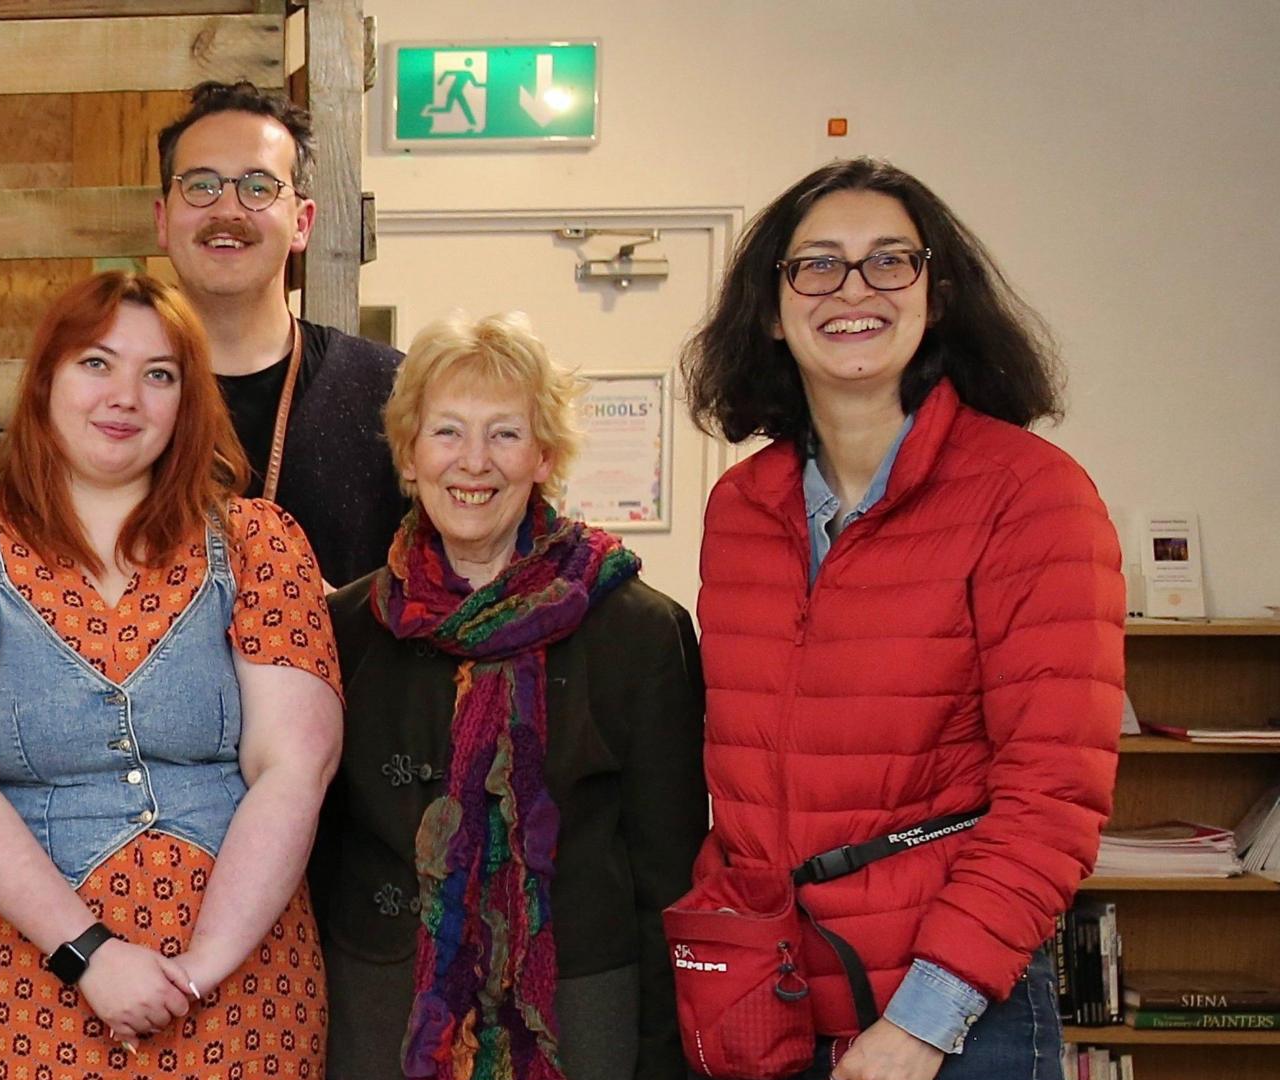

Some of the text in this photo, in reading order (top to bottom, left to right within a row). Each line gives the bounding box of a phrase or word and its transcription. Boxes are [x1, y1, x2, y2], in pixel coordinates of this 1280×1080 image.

[676, 959, 727, 972] DMM
[1181, 994, 1228, 1008] SIENA
[1202, 1014, 1275, 1028] PAINTERS
